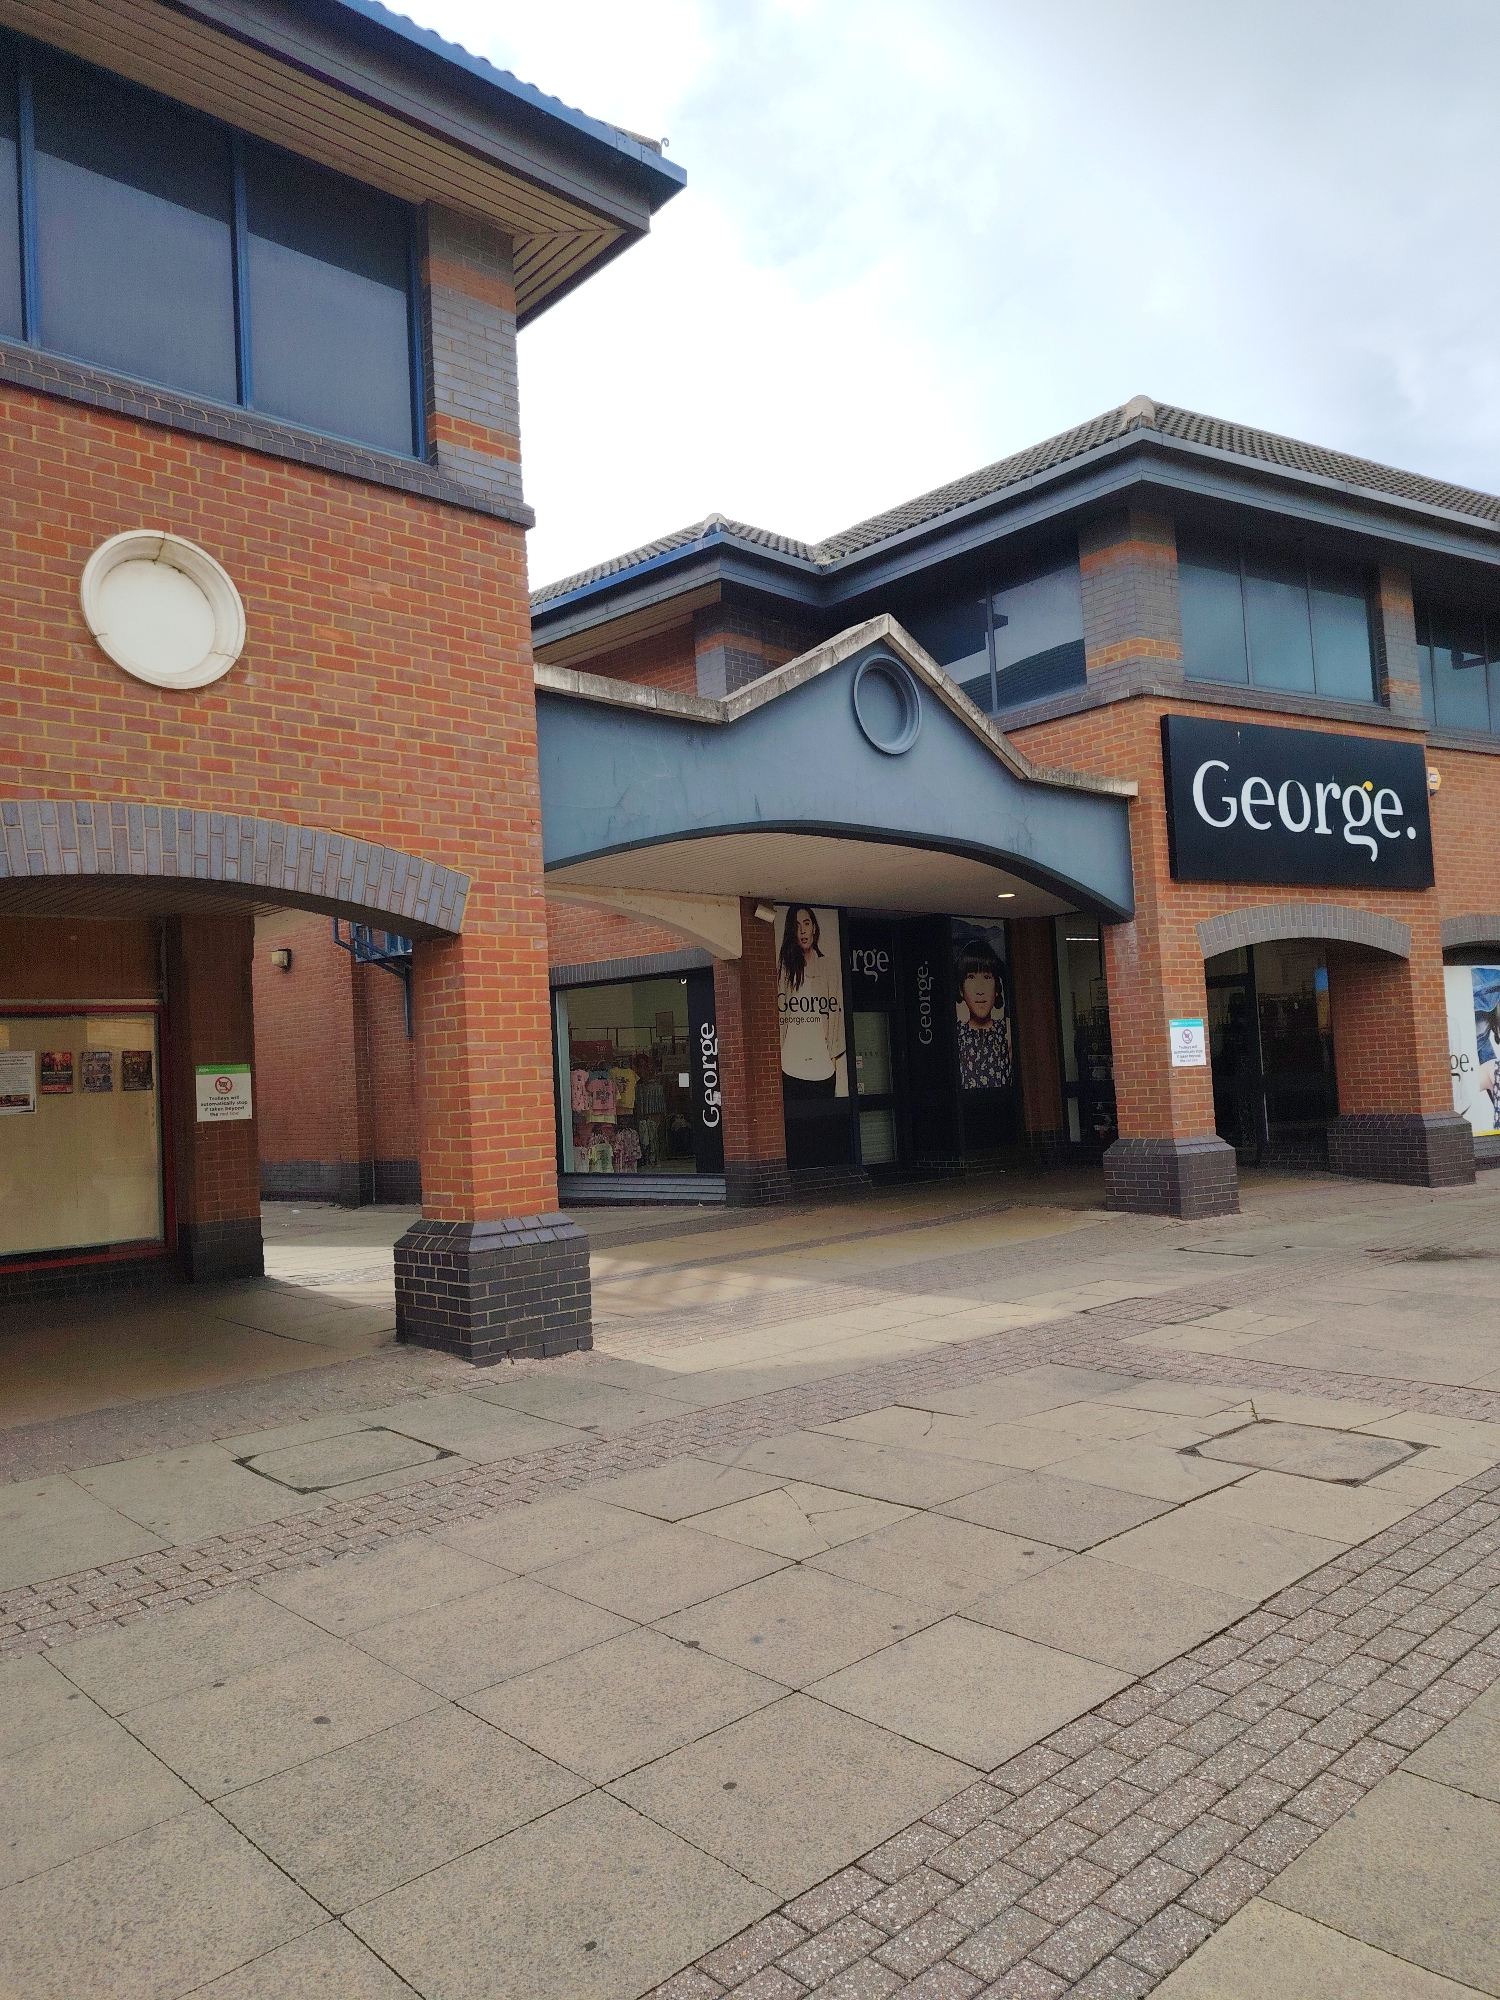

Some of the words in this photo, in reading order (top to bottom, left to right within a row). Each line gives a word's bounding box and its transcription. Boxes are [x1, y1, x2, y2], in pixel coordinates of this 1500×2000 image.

[1192, 760, 1417, 862] George.
[850, 948, 890, 982] rge
[777, 992, 842, 1020] George.
[917, 960, 934, 1045] George.
[779, 1016, 821, 1025] george.com
[700, 1022, 719, 1128] George
[1450, 1053, 1474, 1082] ge.
